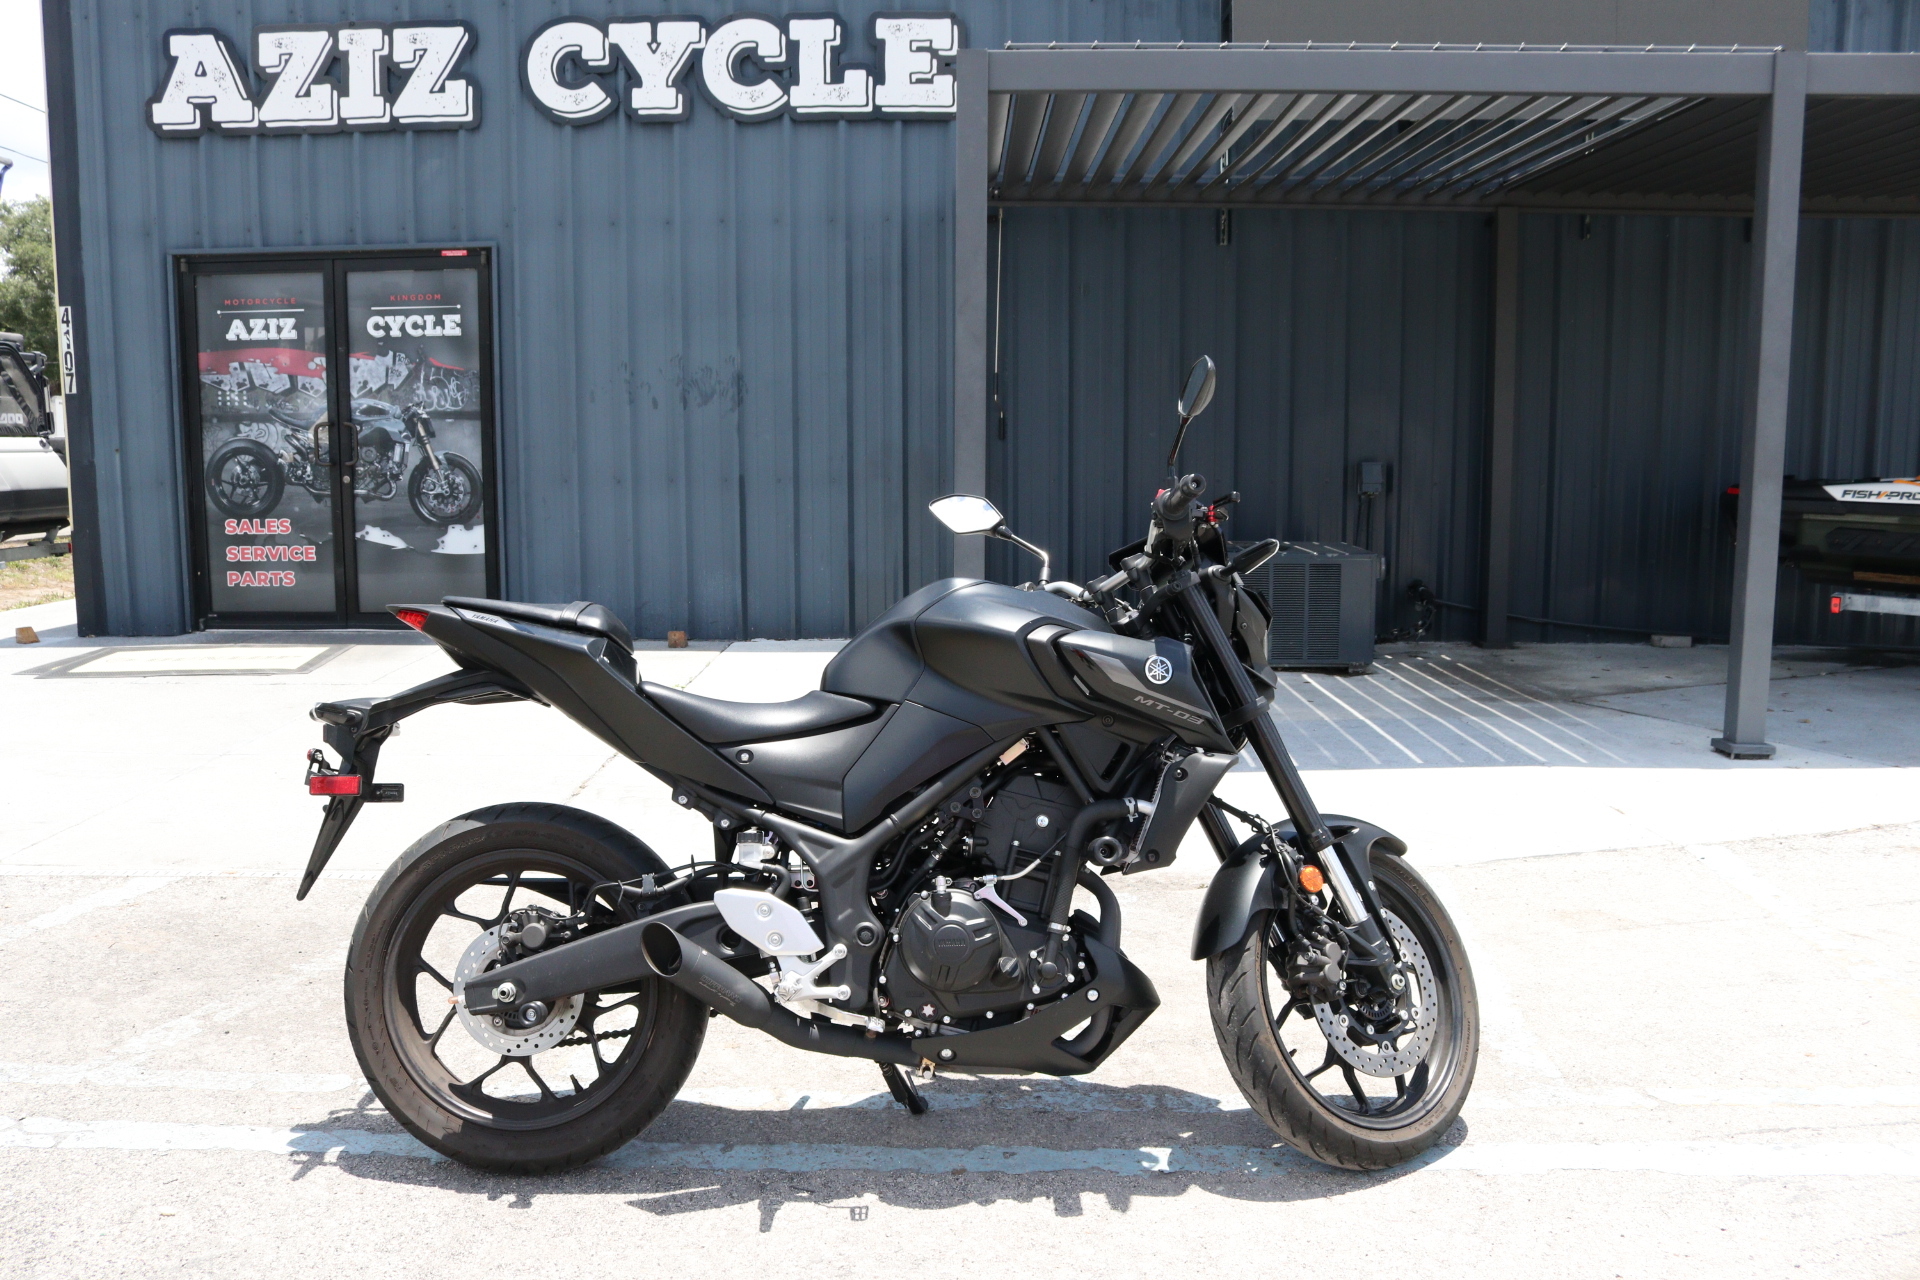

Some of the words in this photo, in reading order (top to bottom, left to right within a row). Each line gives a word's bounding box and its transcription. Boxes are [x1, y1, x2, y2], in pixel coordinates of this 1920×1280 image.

[152, 25, 474, 130] AZIZ
[526, 18, 958, 120] CYCLE
[224, 297, 297, 306] MOTORCYCLE
[390, 293, 442, 302] KINGDOM
[226, 318, 298, 341] AZIZ
[366, 314, 462, 338] CYCLE
[61, 307, 75, 393] 4107
[225, 518, 291, 535] SALES
[226, 545, 316, 562] SERVICE
[227, 571, 295, 587] PARTS
[472, 614, 498, 624] YAMAHA
[1134, 695, 1204, 724] MT-03
